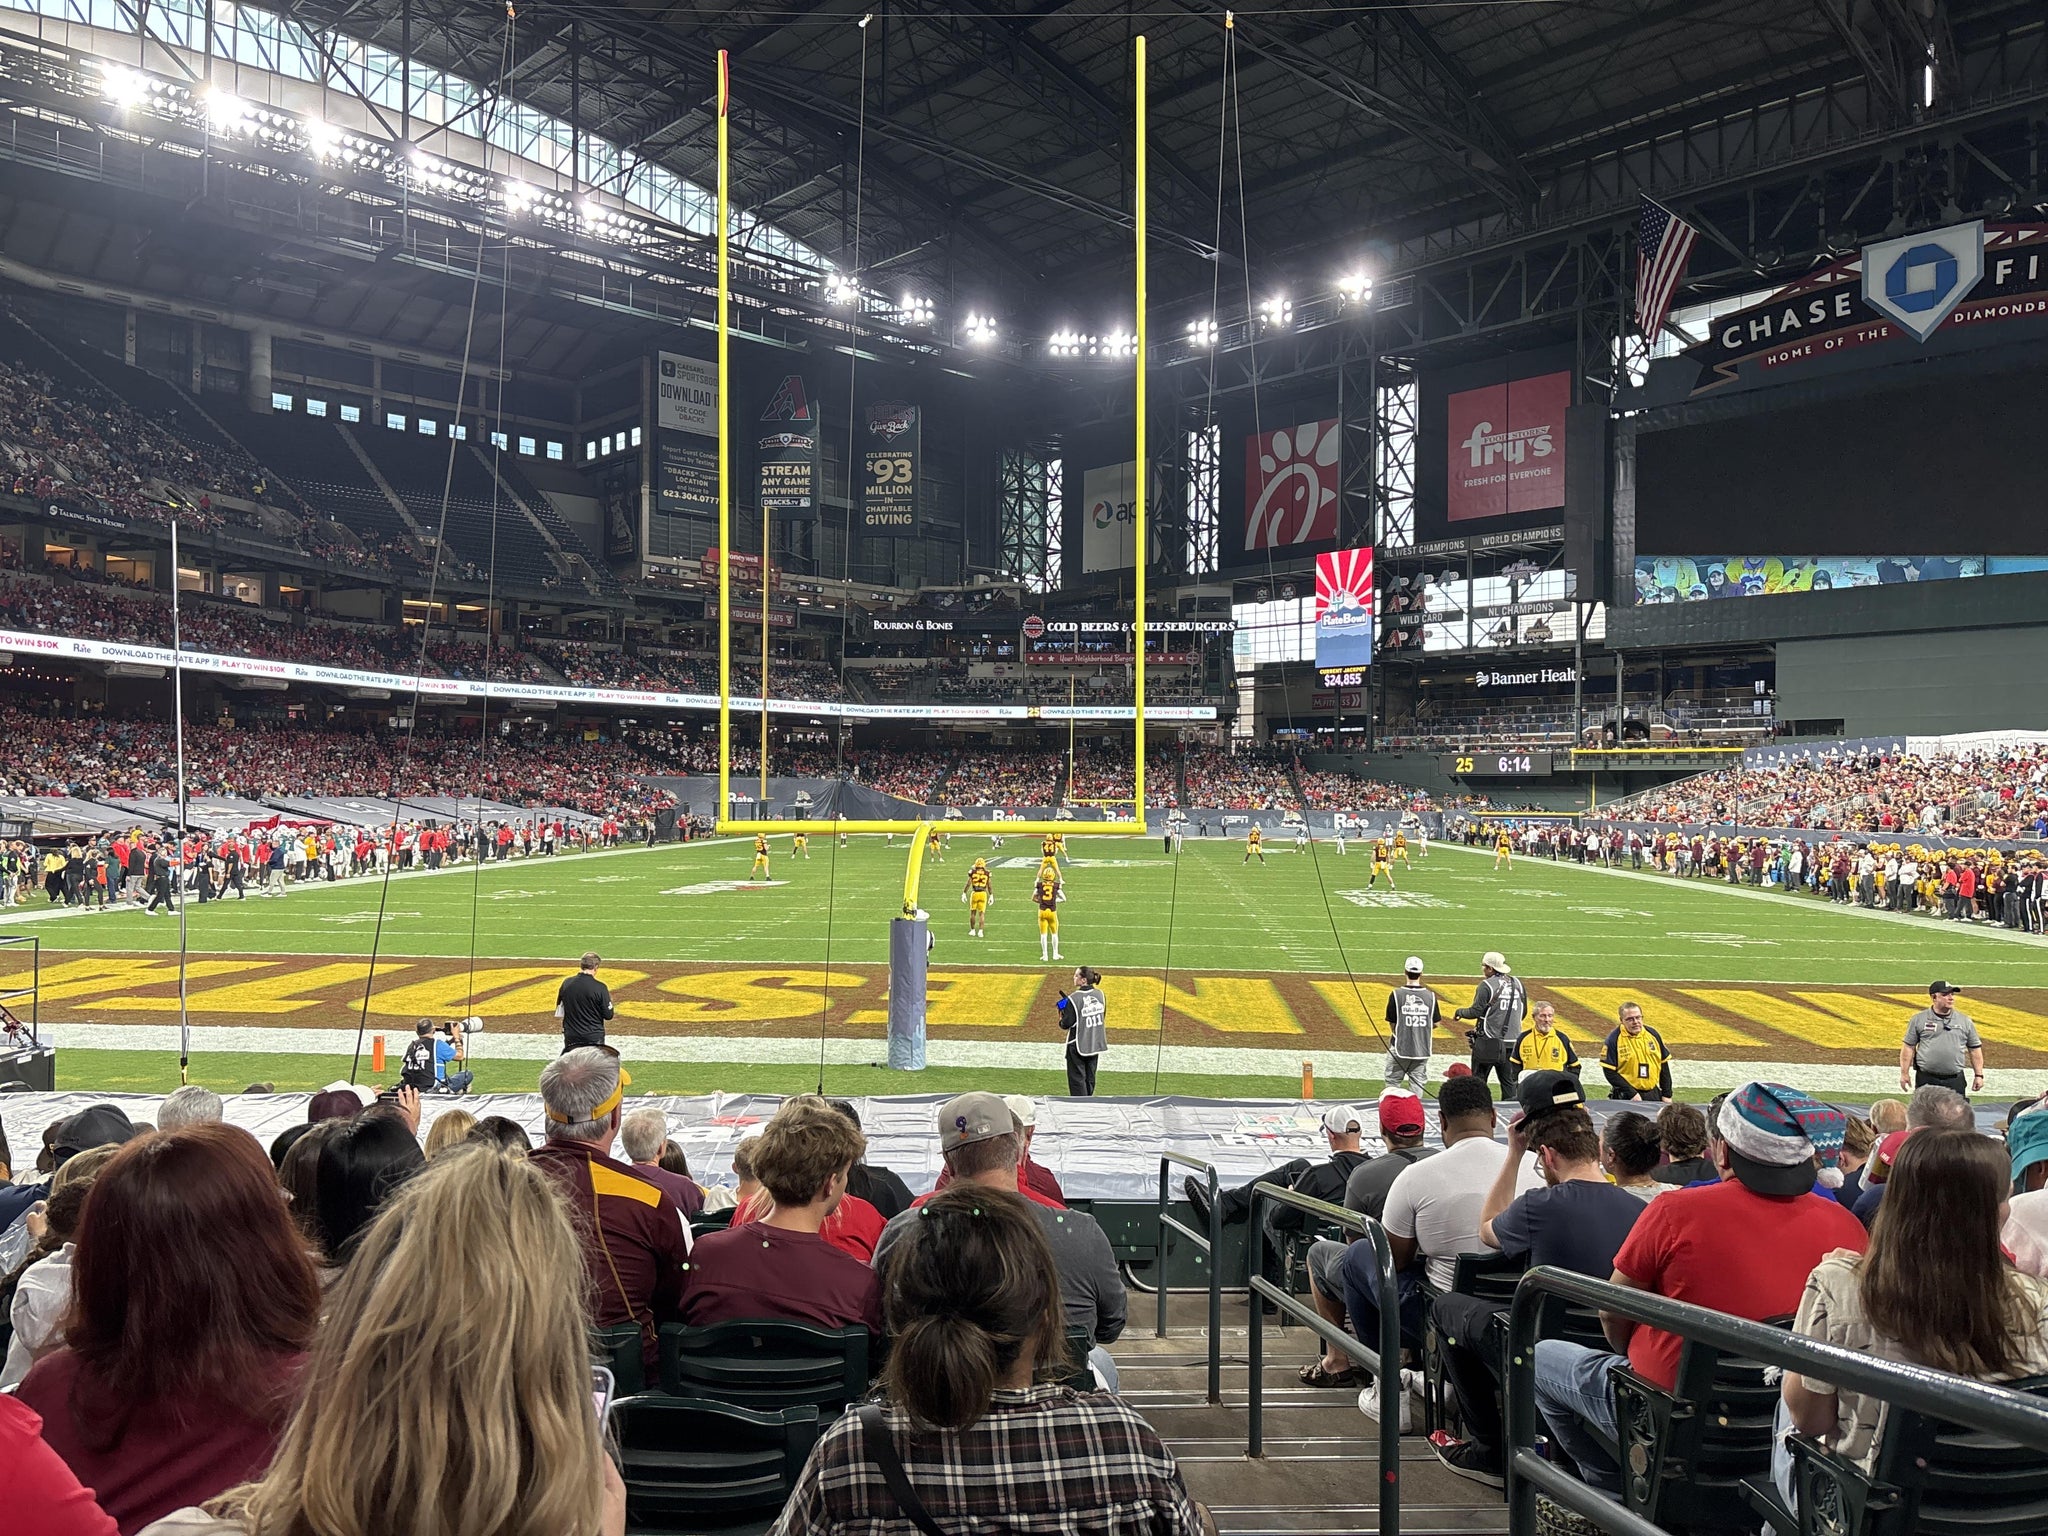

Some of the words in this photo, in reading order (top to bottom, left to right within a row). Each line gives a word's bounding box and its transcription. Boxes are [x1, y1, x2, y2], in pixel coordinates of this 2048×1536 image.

[1722, 292, 1852, 350] CHASE
[1767, 346, 1812, 366] HOME
[1825, 337, 1845, 350] OF
[1857, 326, 1889, 342] THE
[1954, 301, 2046, 323] DIAMONDB
[677, 364, 705, 375] CAESARS
[677, 370, 719, 387] SPORTSBOO
[661, 382, 711, 407] DOWNLOAD
[675, 404, 688, 414] USE
[688, 407, 707, 417] CODE
[679, 413, 705, 424] DBACKS
[699, 451, 720, 461] Conduc
[761, 466, 811, 476] STREAM
[866, 459, 913, 484] $93
[1464, 476, 1489, 488] FRESH
[1490, 473, 1507, 484] FOR
[1509, 466, 1552, 481] EVERYONE
[675, 475, 709, 487] LOCATION
[761, 478, 782, 486] ANY
[783, 478, 811, 486] GAME
[761, 487, 811, 495] ANYWHERE
[865, 486, 913, 495] MILLION
[865, 514, 913, 525] GIVING
[1482, 535, 1511, 546] WORLD
[1511, 527, 1561, 543] CHAMPIONS
[1384, 549, 1395, 558] NL
[1396, 546, 1416, 556] WEST
[1419, 540, 1465, 554] CHAMPIONS
[728, 554, 759, 563] oneywell
[705, 562, 779, 583] SNDLOT
[1488, 607, 1499, 617] NL
[1501, 602, 1554, 616] CHAMPIONS
[915, 620, 924, 630] &
[1400, 615, 1420, 625] WILD
[1421, 613, 1443, 623] CARD
[1047, 622, 1078, 632] COLD
[1081, 622, 1120, 632] BEERS
[1121, 622, 1129, 632] &
[15, 638, 35, 648] WIN
[37, 639, 59, 650] $10K
[73, 643, 92, 654] Rate
[102, 646, 154, 660] DOWNLOAD
[155, 652, 173, 662] THE
[195, 656, 210, 665] APP
[221, 660, 241, 669] PLAY
[242, 662, 252, 670] TO
[253, 663, 269, 672] WIN
[269, 665, 286, 673] $10K
[316, 670, 353, 680] DOWNLOAD
[353, 674, 366, 682] THE
[366, 675, 382, 683] RATE
[382, 676, 394, 684] APP
[493, 686, 537, 695] DOWNLOAD
[538, 688, 553, 696] THE
[597, 692, 614, 700] PLAY
[1028, 707, 1040, 717] 25
[1324, 673, 1362, 687] $24,855
[1490, 671, 1539, 686] Banner
[1455, 757, 1474, 773] 25
[1498, 756, 1531, 772] 6:14
[971, 873, 989, 888] 23
[1042, 885, 1053, 901] 3
[1086, 1014, 1103, 1028] 011
[1405, 1015, 1427, 1027] 025
